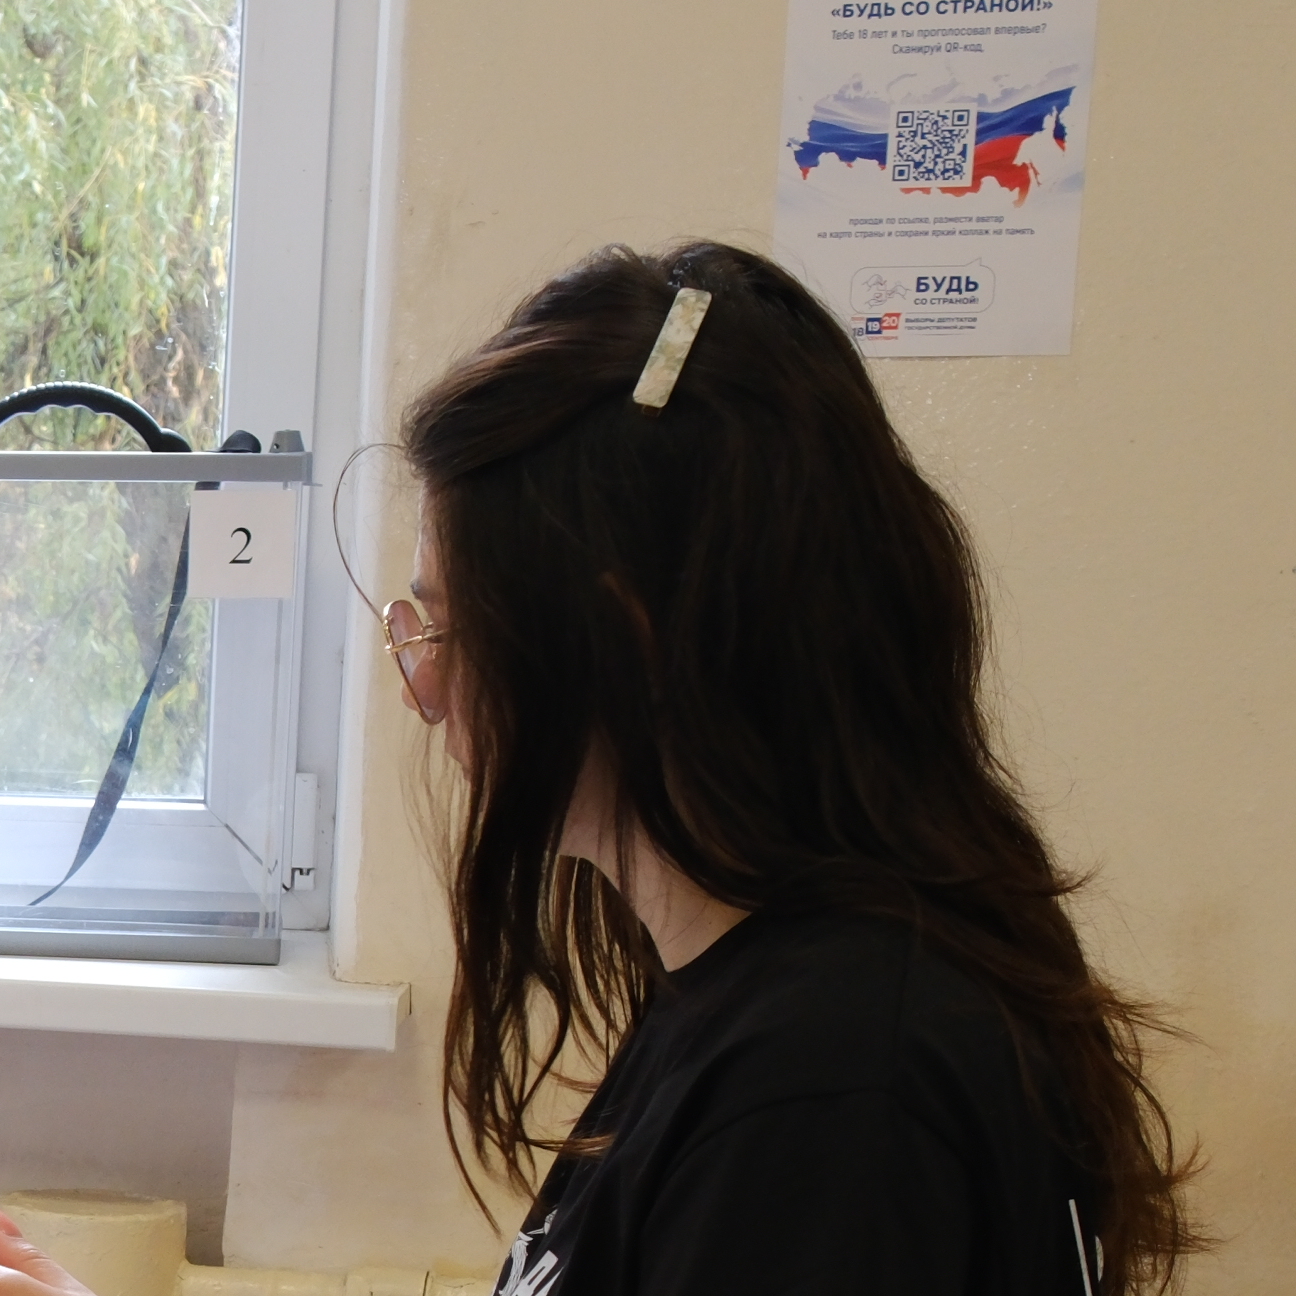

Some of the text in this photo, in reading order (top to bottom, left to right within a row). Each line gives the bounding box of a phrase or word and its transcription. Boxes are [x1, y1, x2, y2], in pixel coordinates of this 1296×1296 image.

[831, 0, 1053, 19] «БУДЬ СО СТРАНОЙ!»
[831, 23, 1047, 40] Тебе 18 лет и ты проголосовал впервые?
[892, 43, 942, 55] Сканируй
[854, 230, 886, 239] страны
[915, 276, 979, 294] БУДЬ
[930, 296, 979, 305] СТРАНОЙ!
[867, 320, 881, 332] 19
[881, 315, 898, 327] 20
[228, 527, 254, 565] 2
